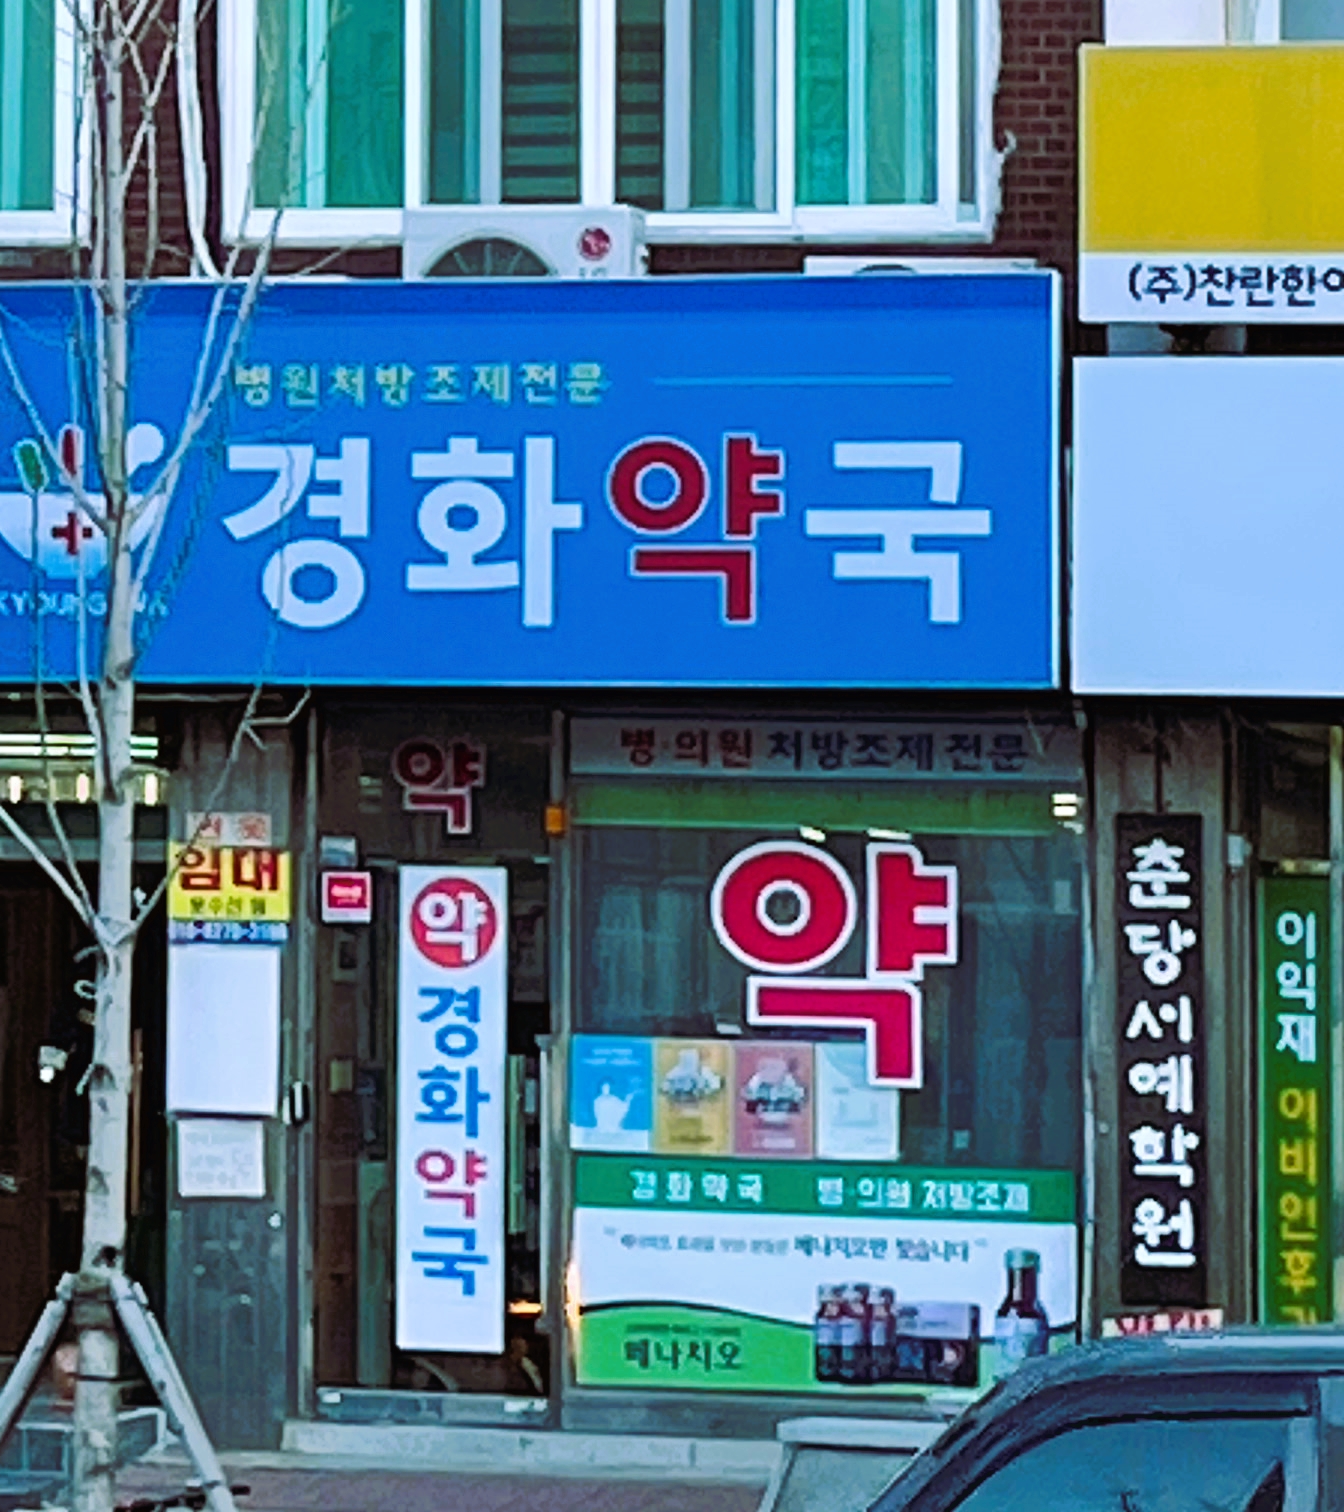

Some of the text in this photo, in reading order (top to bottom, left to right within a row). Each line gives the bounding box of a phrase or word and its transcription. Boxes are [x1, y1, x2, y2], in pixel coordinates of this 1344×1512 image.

[234, 361, 613, 407] 병원처방조제전문
[221, 431, 992, 630] 경화약국
[393, 736, 488, 835] 약
[767, 729, 935, 772] 처방조제
[944, 731, 1030, 774] 전문
[176, 846, 281, 892] 임대
[416, 890, 488, 962] 약
[711, 840, 958, 1089] 약
[1275, 910, 1317, 1064] 이익재
[1125, 836, 1200, 1268] 춘당서예학원
[411, 985, 491, 1297] 경화약국
